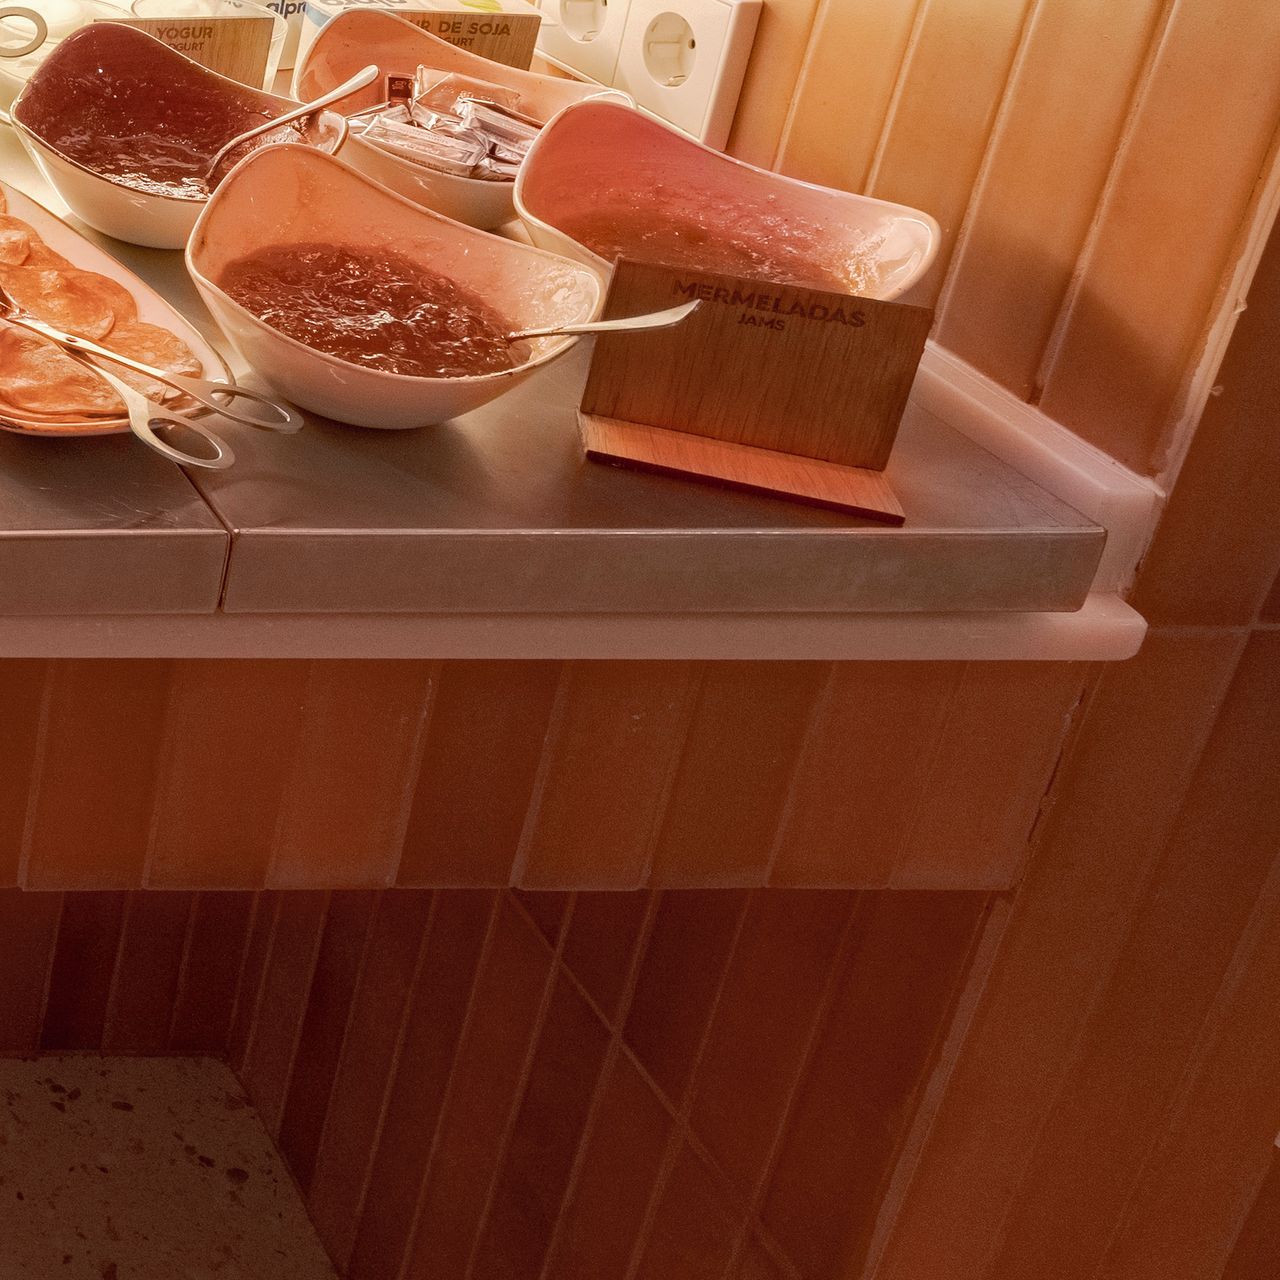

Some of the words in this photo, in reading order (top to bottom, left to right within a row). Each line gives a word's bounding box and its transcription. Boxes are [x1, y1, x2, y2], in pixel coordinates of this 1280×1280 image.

[156, 26, 213, 39] YOGUR
[438, 21, 462, 33] DE
[467, 22, 511, 35] SOJA
[672, 279, 866, 328] MERMELADAS
[737, 313, 785, 332] JAMS
